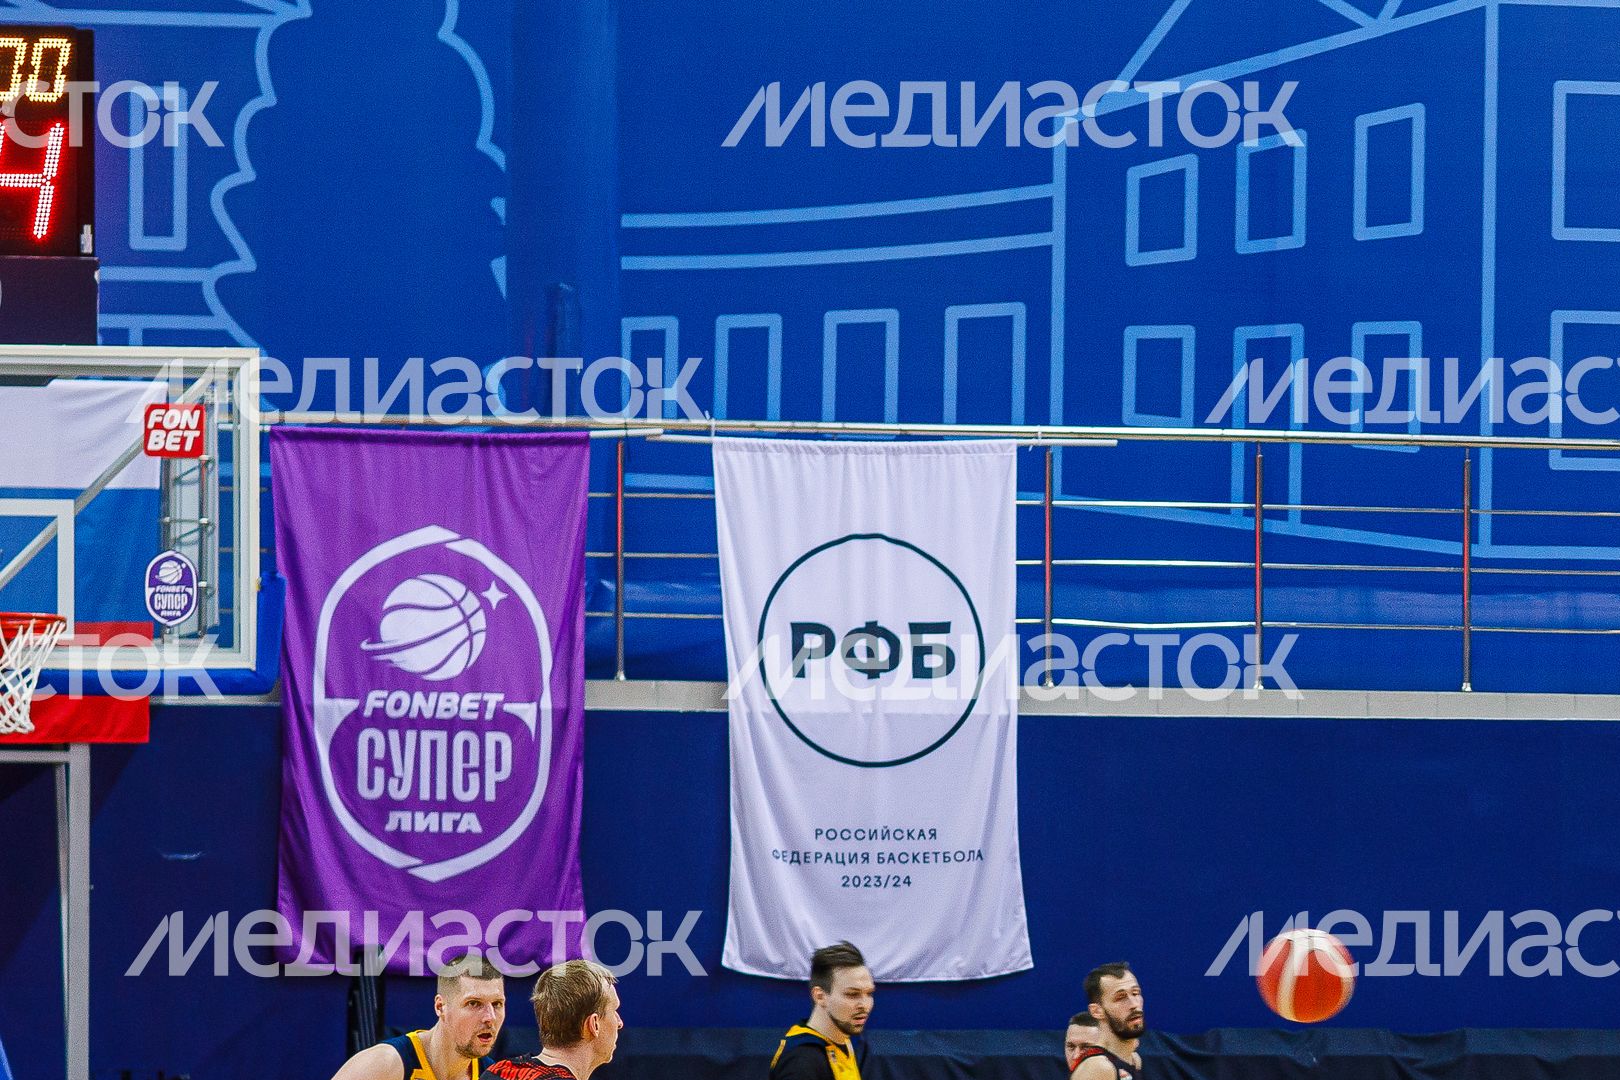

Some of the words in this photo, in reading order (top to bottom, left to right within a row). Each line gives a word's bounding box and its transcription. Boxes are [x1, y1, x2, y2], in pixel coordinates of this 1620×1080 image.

[147, 408, 200, 430] FON
[146, 430, 200, 452] BET
[789, 619, 956, 681] РФБ
[363, 690, 505, 721] FONBET
[384, 811, 483, 833] ЛИГА
[814, 826, 938, 841] РОССИЙСКАЯ
[877, 849, 984, 864] БАСКЕТБОЛА
[841, 875, 912, 888] 2023/24
